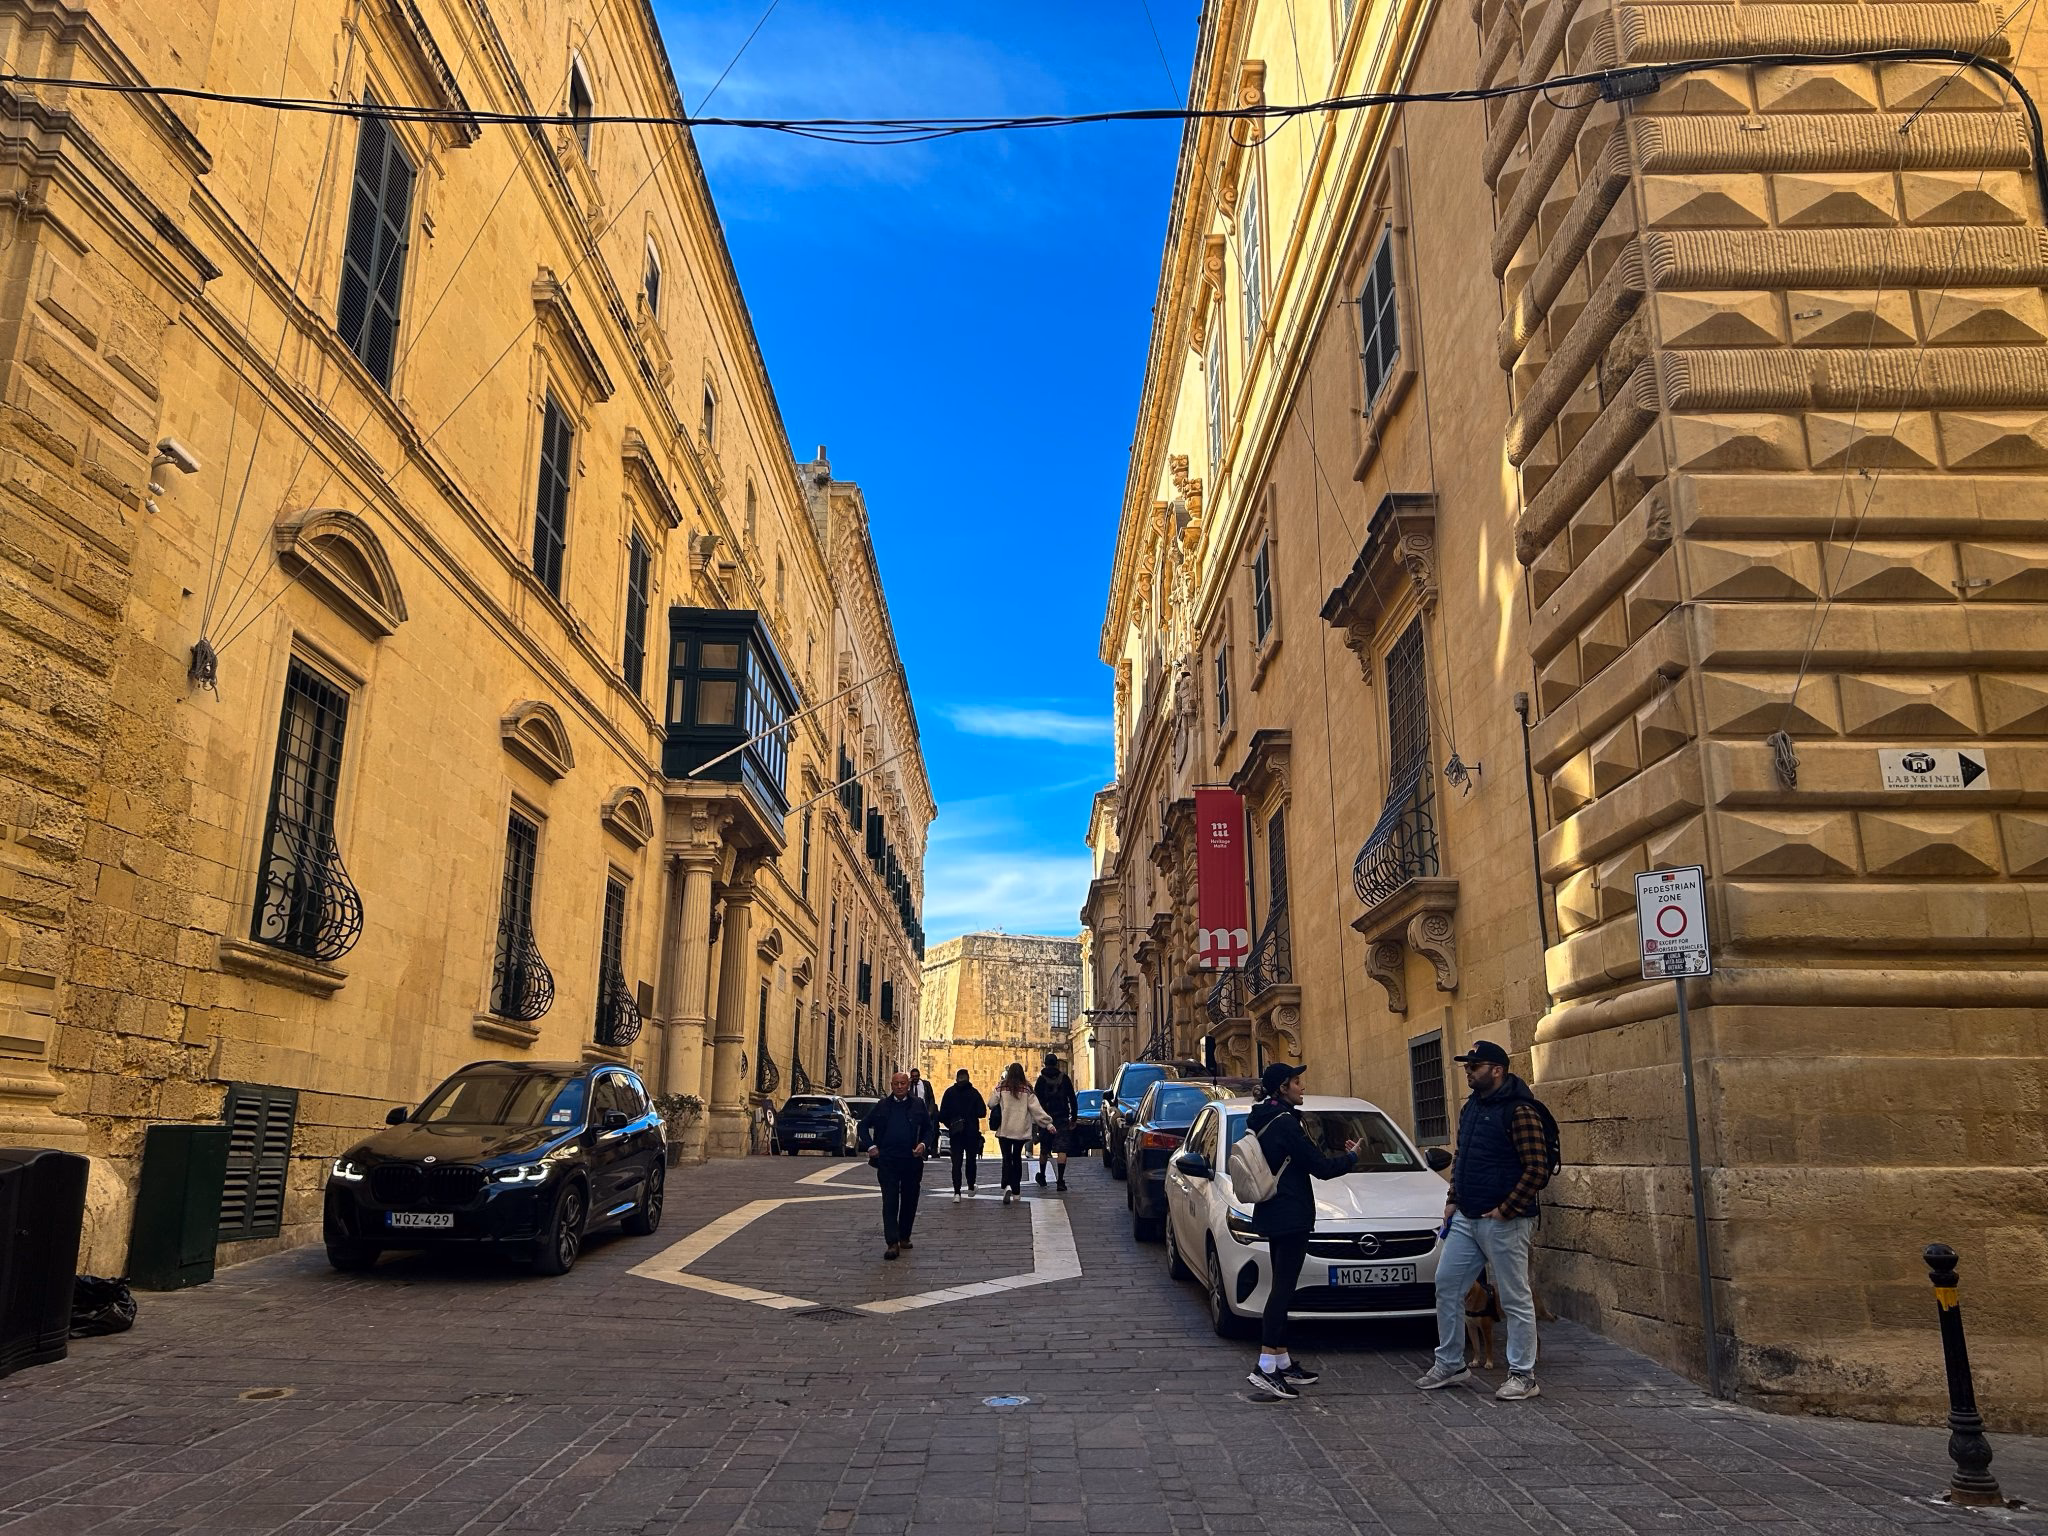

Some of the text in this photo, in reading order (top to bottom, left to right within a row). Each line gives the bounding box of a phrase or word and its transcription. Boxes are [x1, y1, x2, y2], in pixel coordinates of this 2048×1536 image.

[1887, 775, 1960, 783] LABYRINTH
[1643, 882, 1696, 894] PEDESTRIAN
[1658, 894, 1682, 902] ZONE
